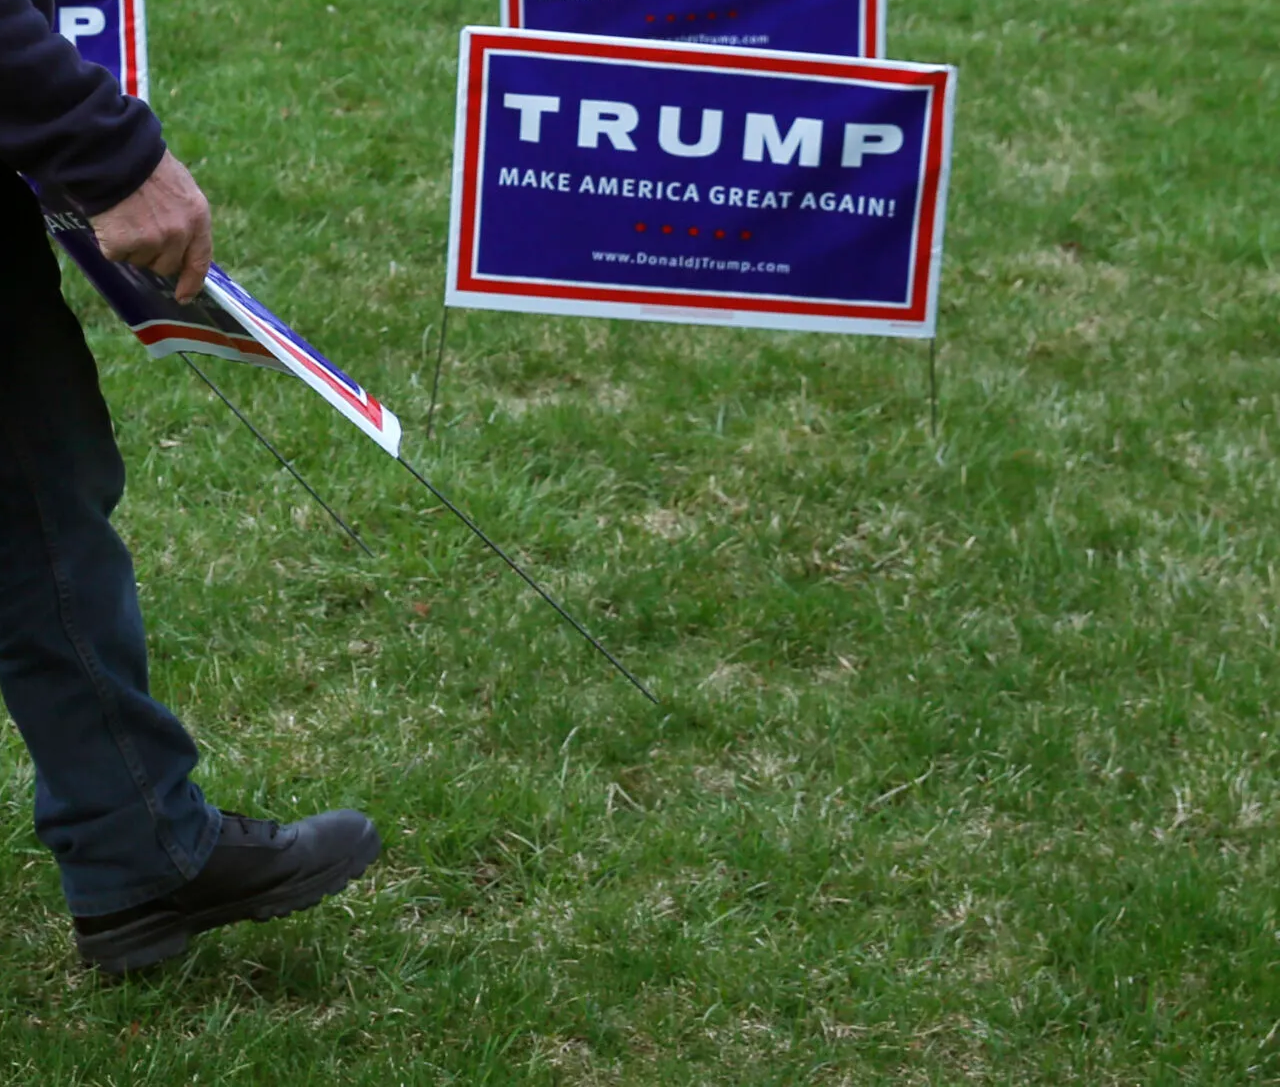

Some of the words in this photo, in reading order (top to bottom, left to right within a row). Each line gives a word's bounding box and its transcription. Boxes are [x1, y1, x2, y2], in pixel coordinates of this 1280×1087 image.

[503, 92, 905, 168] TRUMP
[498, 167, 571, 193] MAKE
[578, 175, 700, 203] AMERICA
[708, 185, 794, 209] GREAT
[799, 192, 896, 217] AGAIN!
[44, 212, 87, 234] AKE
[591, 250, 791, 274] www.DonaldJTrump.com
